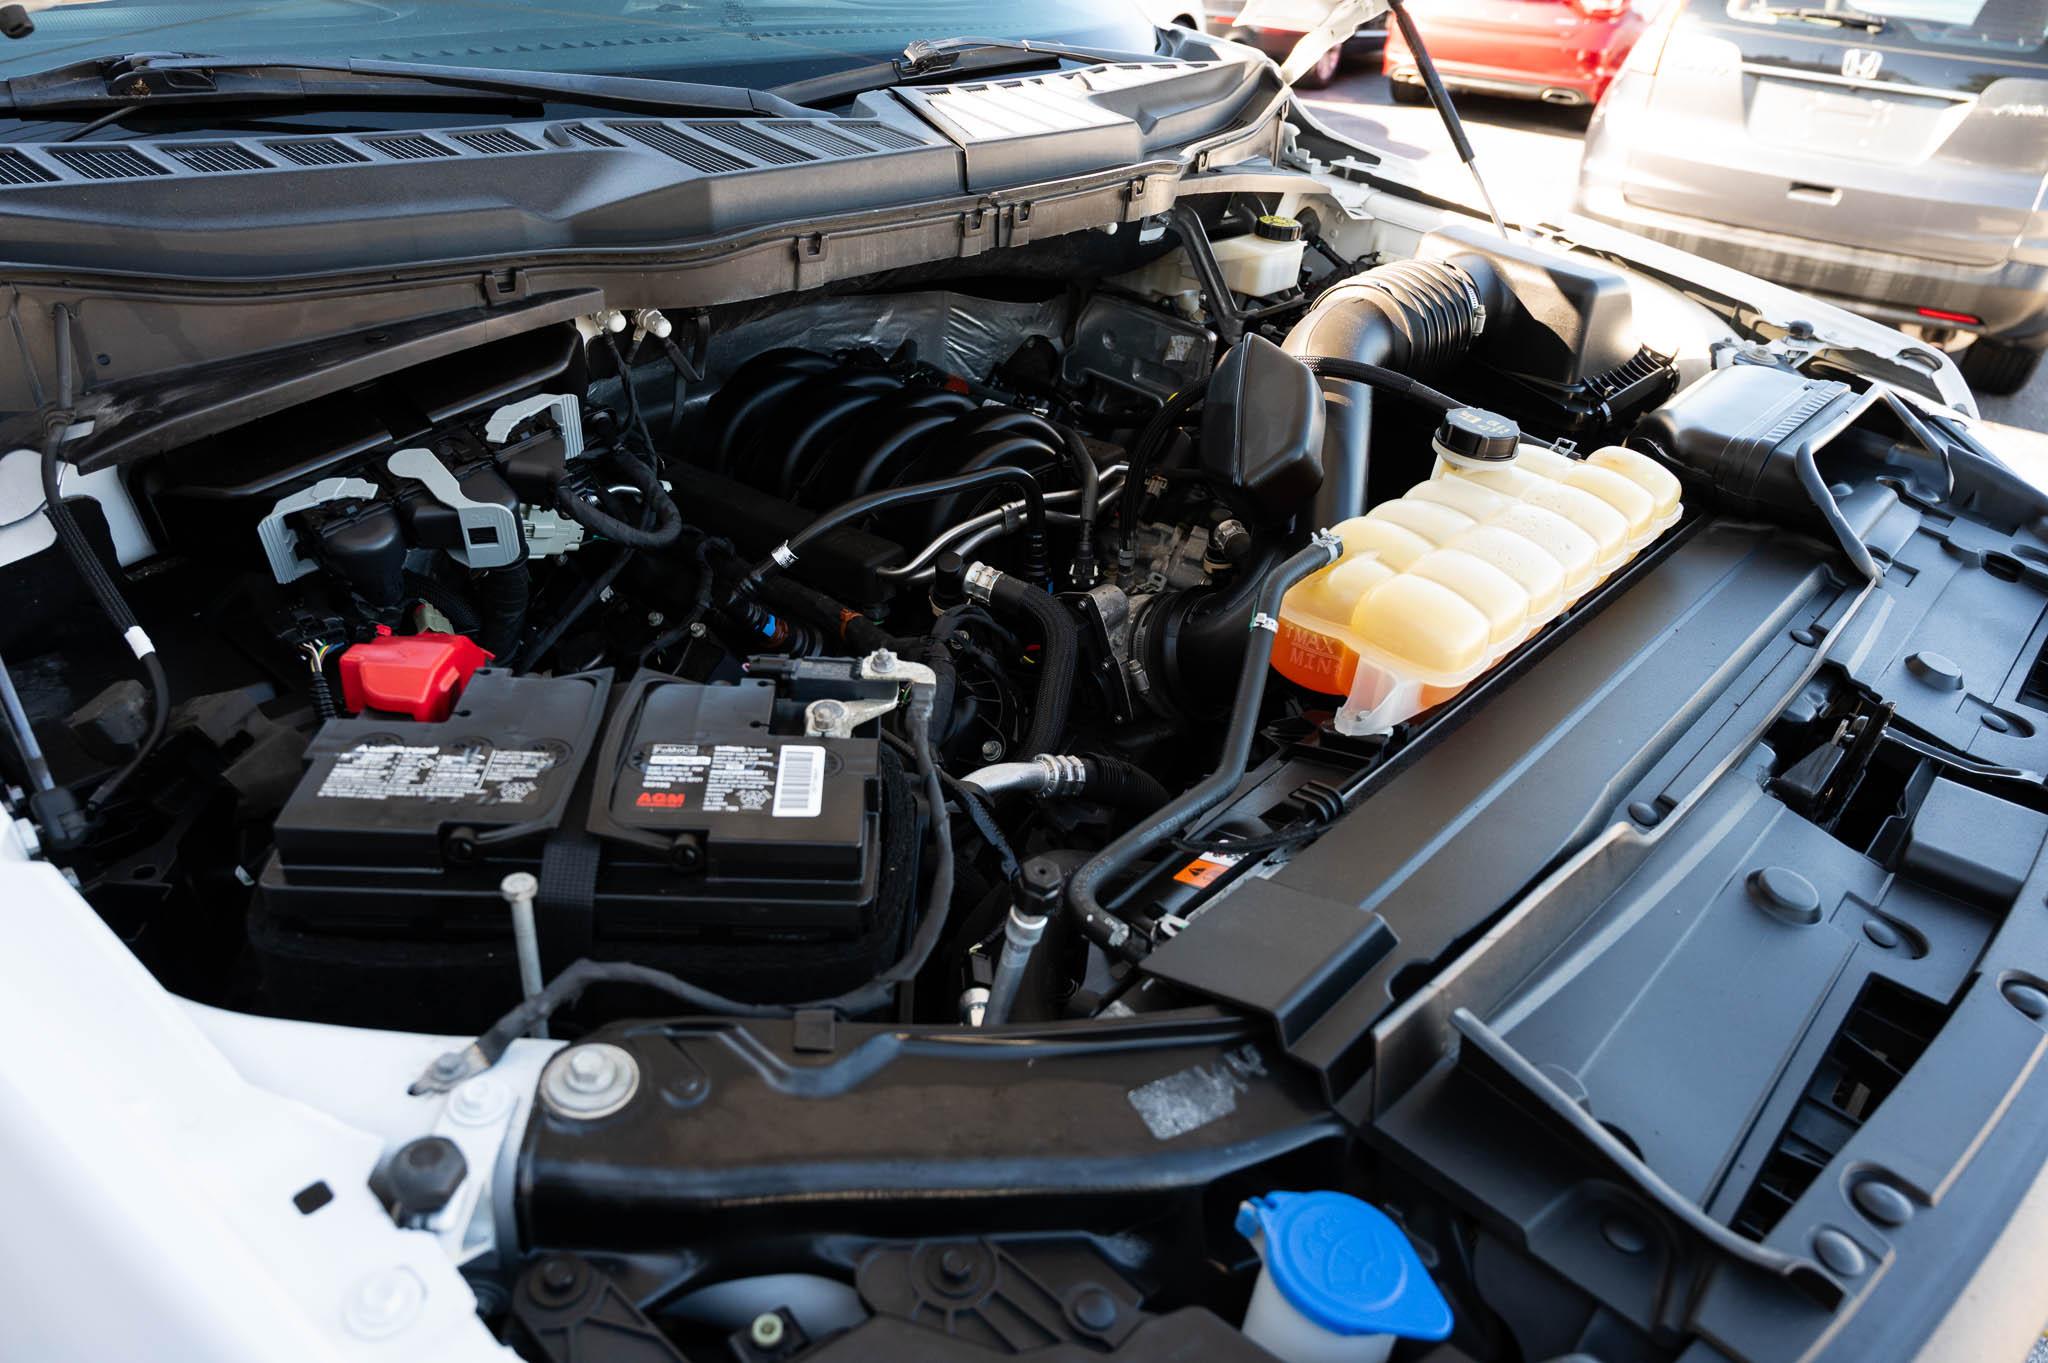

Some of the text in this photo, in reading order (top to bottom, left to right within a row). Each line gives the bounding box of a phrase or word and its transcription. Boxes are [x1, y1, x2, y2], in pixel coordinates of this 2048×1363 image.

[1293, 628, 1334, 654] MAX
[1289, 647, 1332, 674] MIN
[636, 792, 685, 807] AGM
